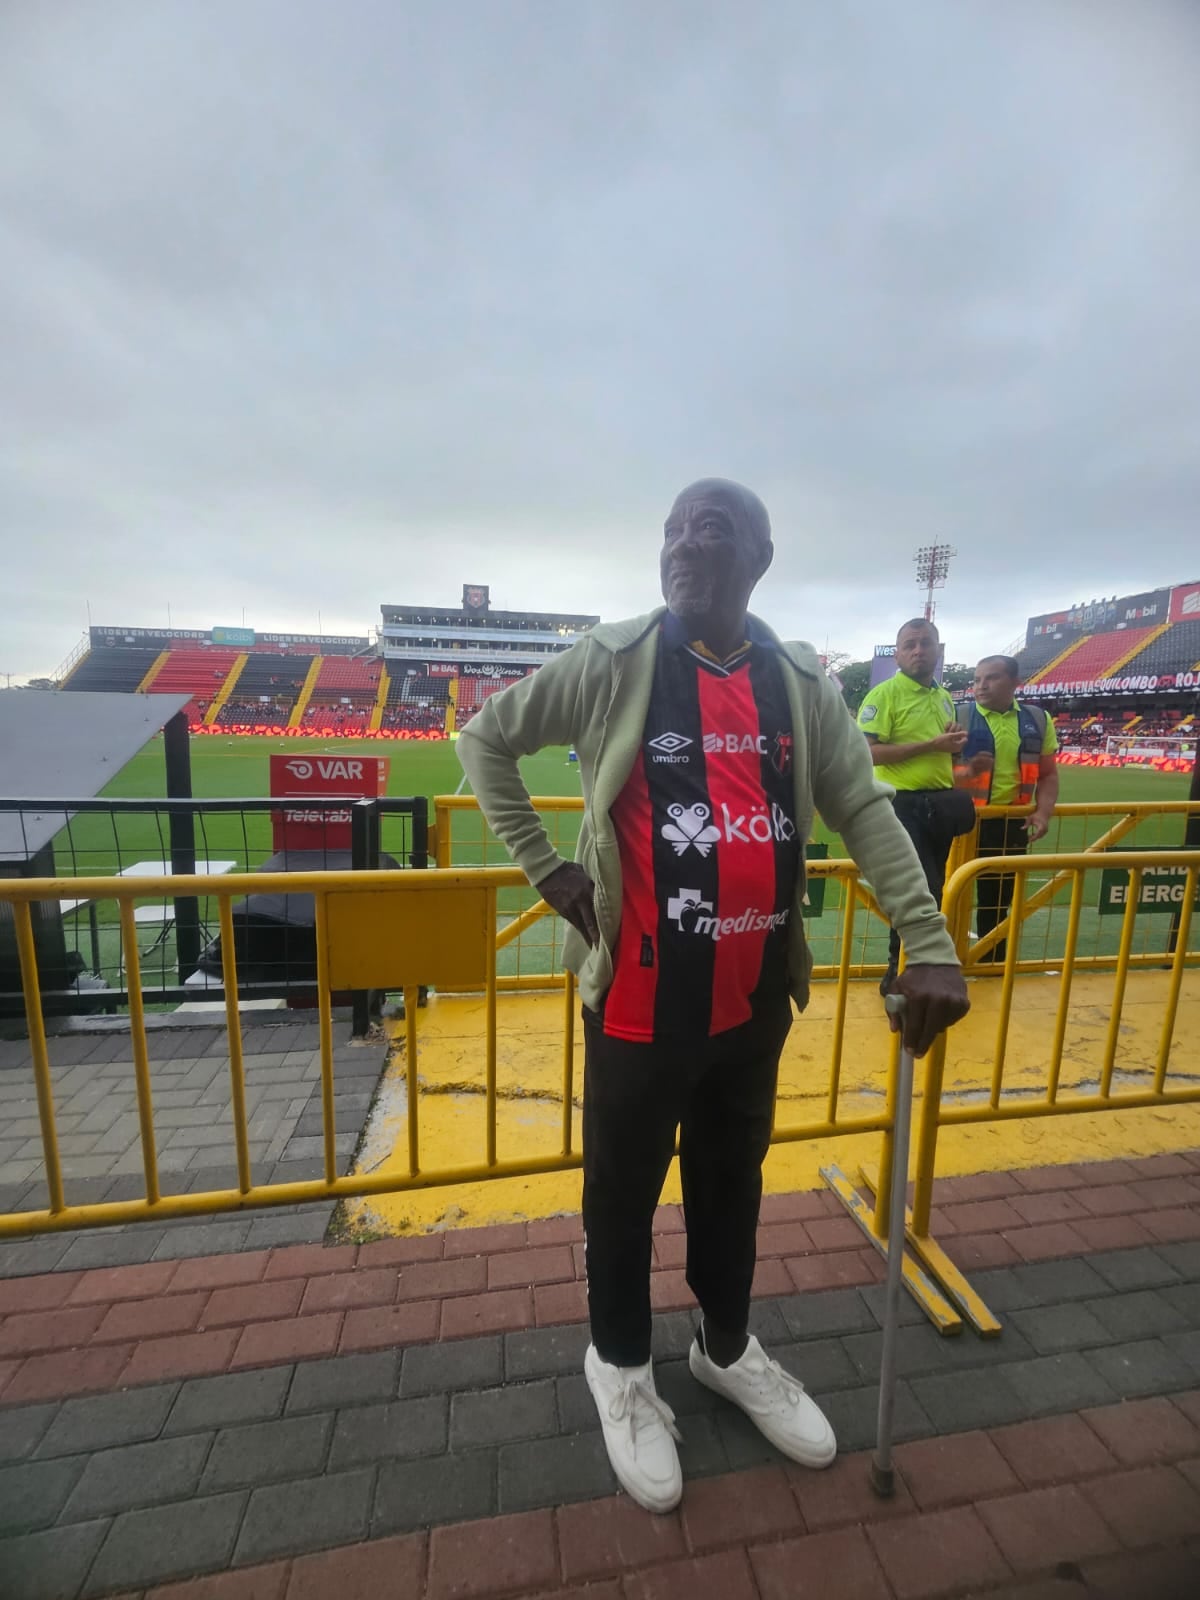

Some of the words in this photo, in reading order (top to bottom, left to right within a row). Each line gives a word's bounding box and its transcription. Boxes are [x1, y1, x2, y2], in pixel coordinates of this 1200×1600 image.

[1125, 605, 1157, 620] Mobil
[1034, 623, 1057, 636] Mobil
[441, 664, 458, 673] BAC
[463, 663, 482, 674] Dos
[494, 664, 524, 676] Pinos
[1100, 675, 1158, 691] QUILOMBO
[725, 734, 768, 755] BAC
[652, 754, 690, 763] umbro
[317, 760, 364, 780] VAR
